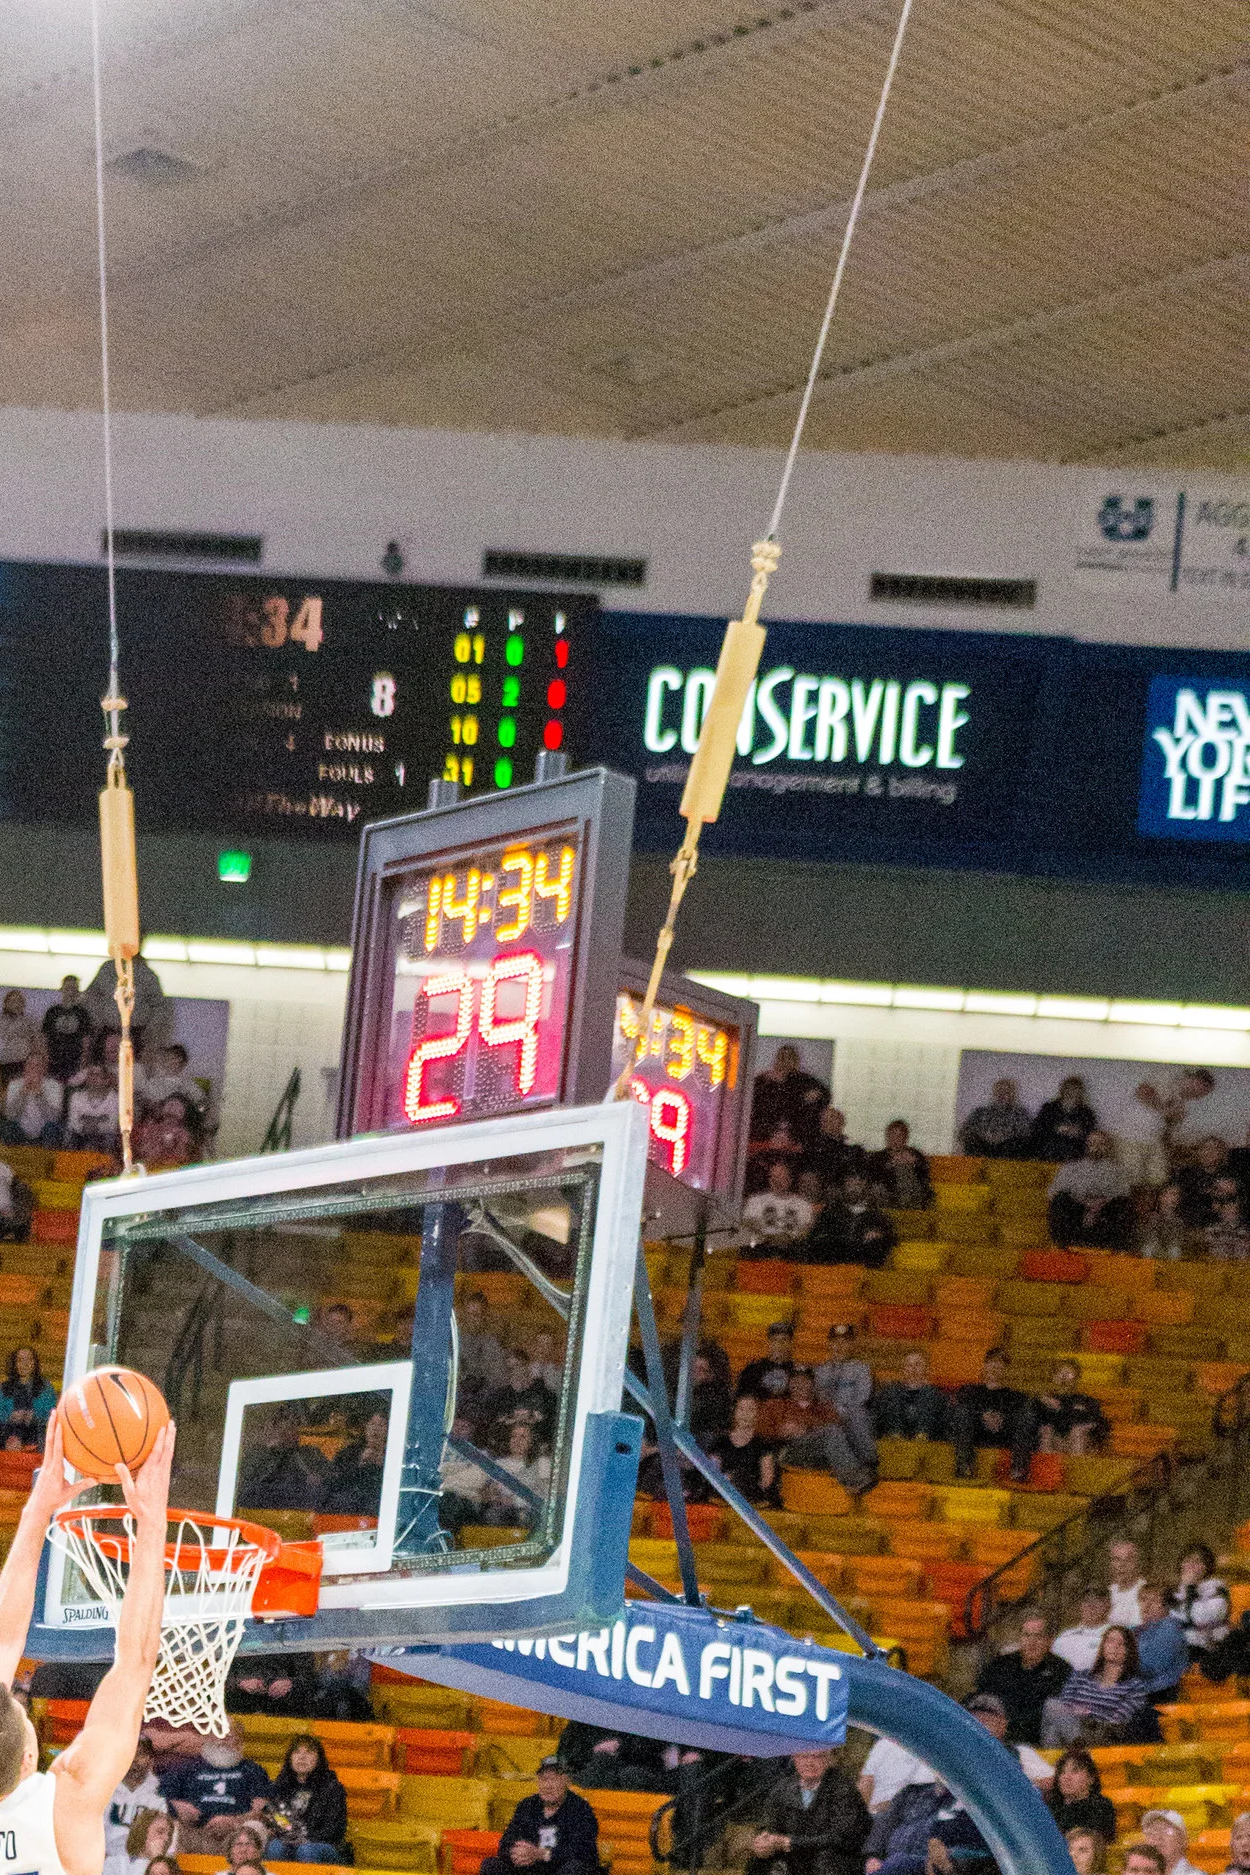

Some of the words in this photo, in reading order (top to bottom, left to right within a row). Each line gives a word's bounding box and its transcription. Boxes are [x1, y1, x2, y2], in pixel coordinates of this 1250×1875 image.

[454, 632, 485, 664] 01
[505, 634, 524, 667] 0
[371, 671, 396, 717] 8
[451, 672, 482, 704] 05
[502, 675, 520, 707] 2
[451, 714, 478, 746] 10
[499, 716, 516, 748] 0
[644, 664, 971, 769] COSERVICE
[494, 755, 512, 788] 0
[424, 842, 574, 953] 14:34
[405, 951, 546, 1125] 29
[62, 1606, 109, 1624] SPALDING
[699, 1641, 841, 1722] FIRST
